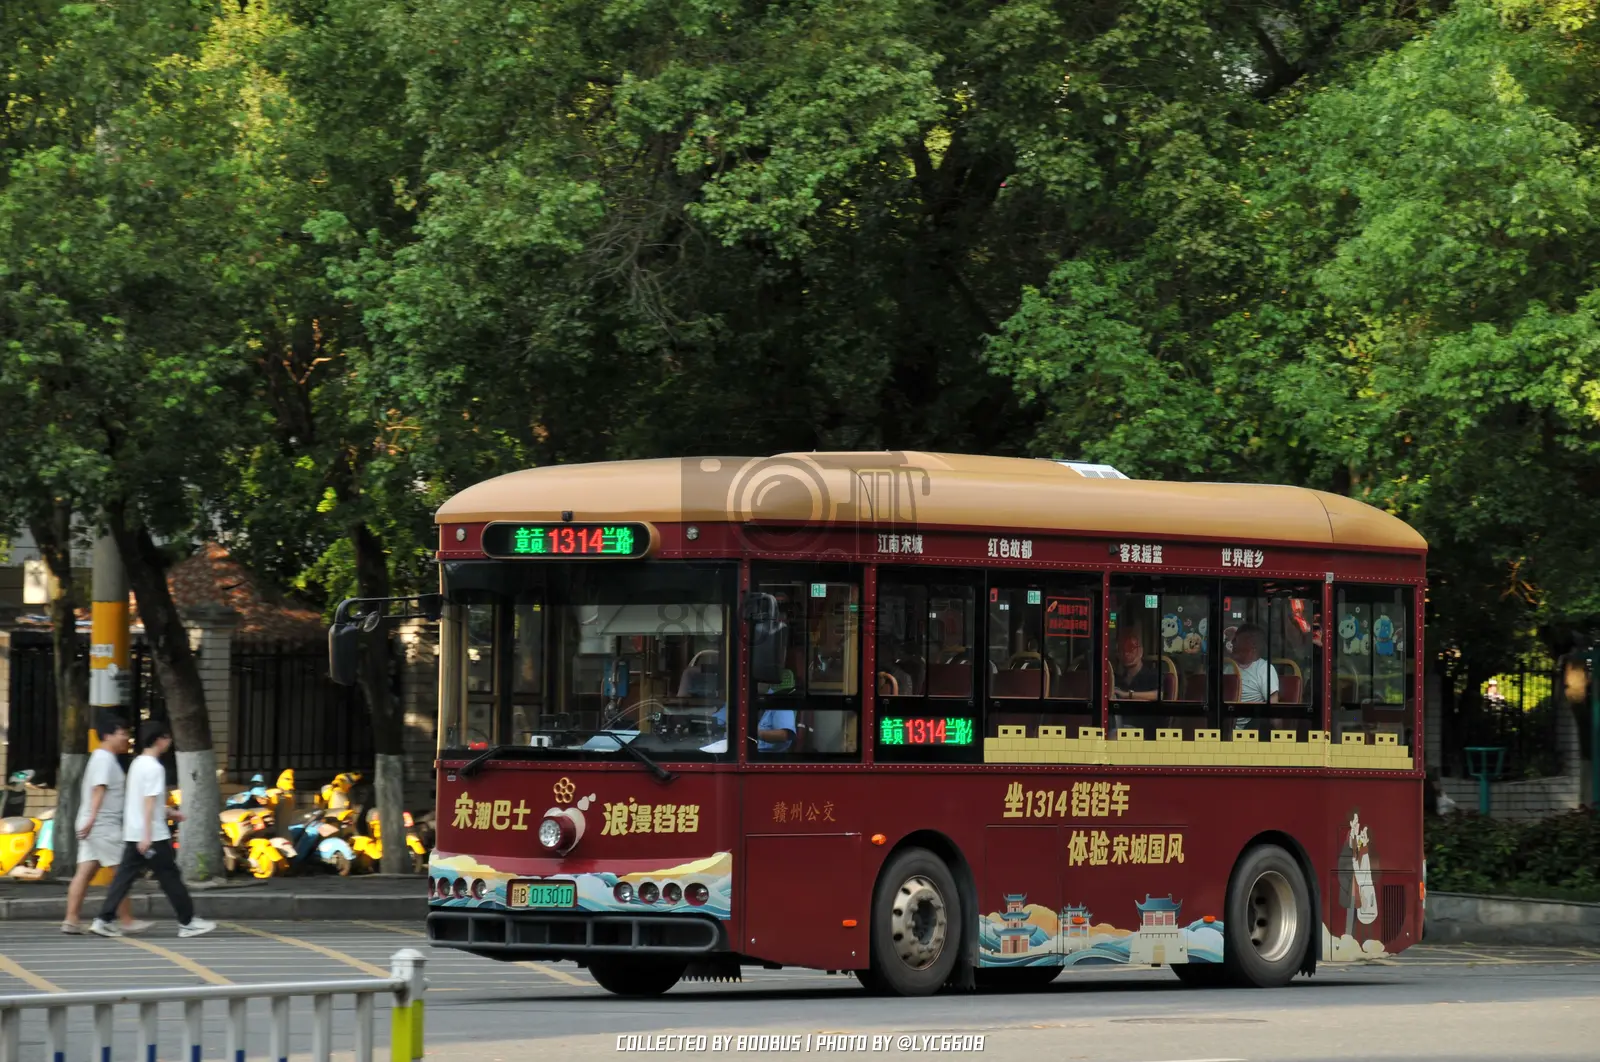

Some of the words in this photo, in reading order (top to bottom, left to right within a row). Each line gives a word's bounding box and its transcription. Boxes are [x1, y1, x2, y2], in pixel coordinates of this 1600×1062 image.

[877, 534, 924, 555] 江南宋城
[987, 537, 1033, 560] 红色故都
[1119, 543, 1164, 565] 客家摇篮
[1221, 547, 1265, 569] 世界橙乡
[451, 791, 531, 831] 宋潮巴士
[600, 797, 700, 836] 浪漫铛铛
[772, 800, 837, 823] 赣州公交
[1067, 830, 1185, 867] 体验宋城国风
